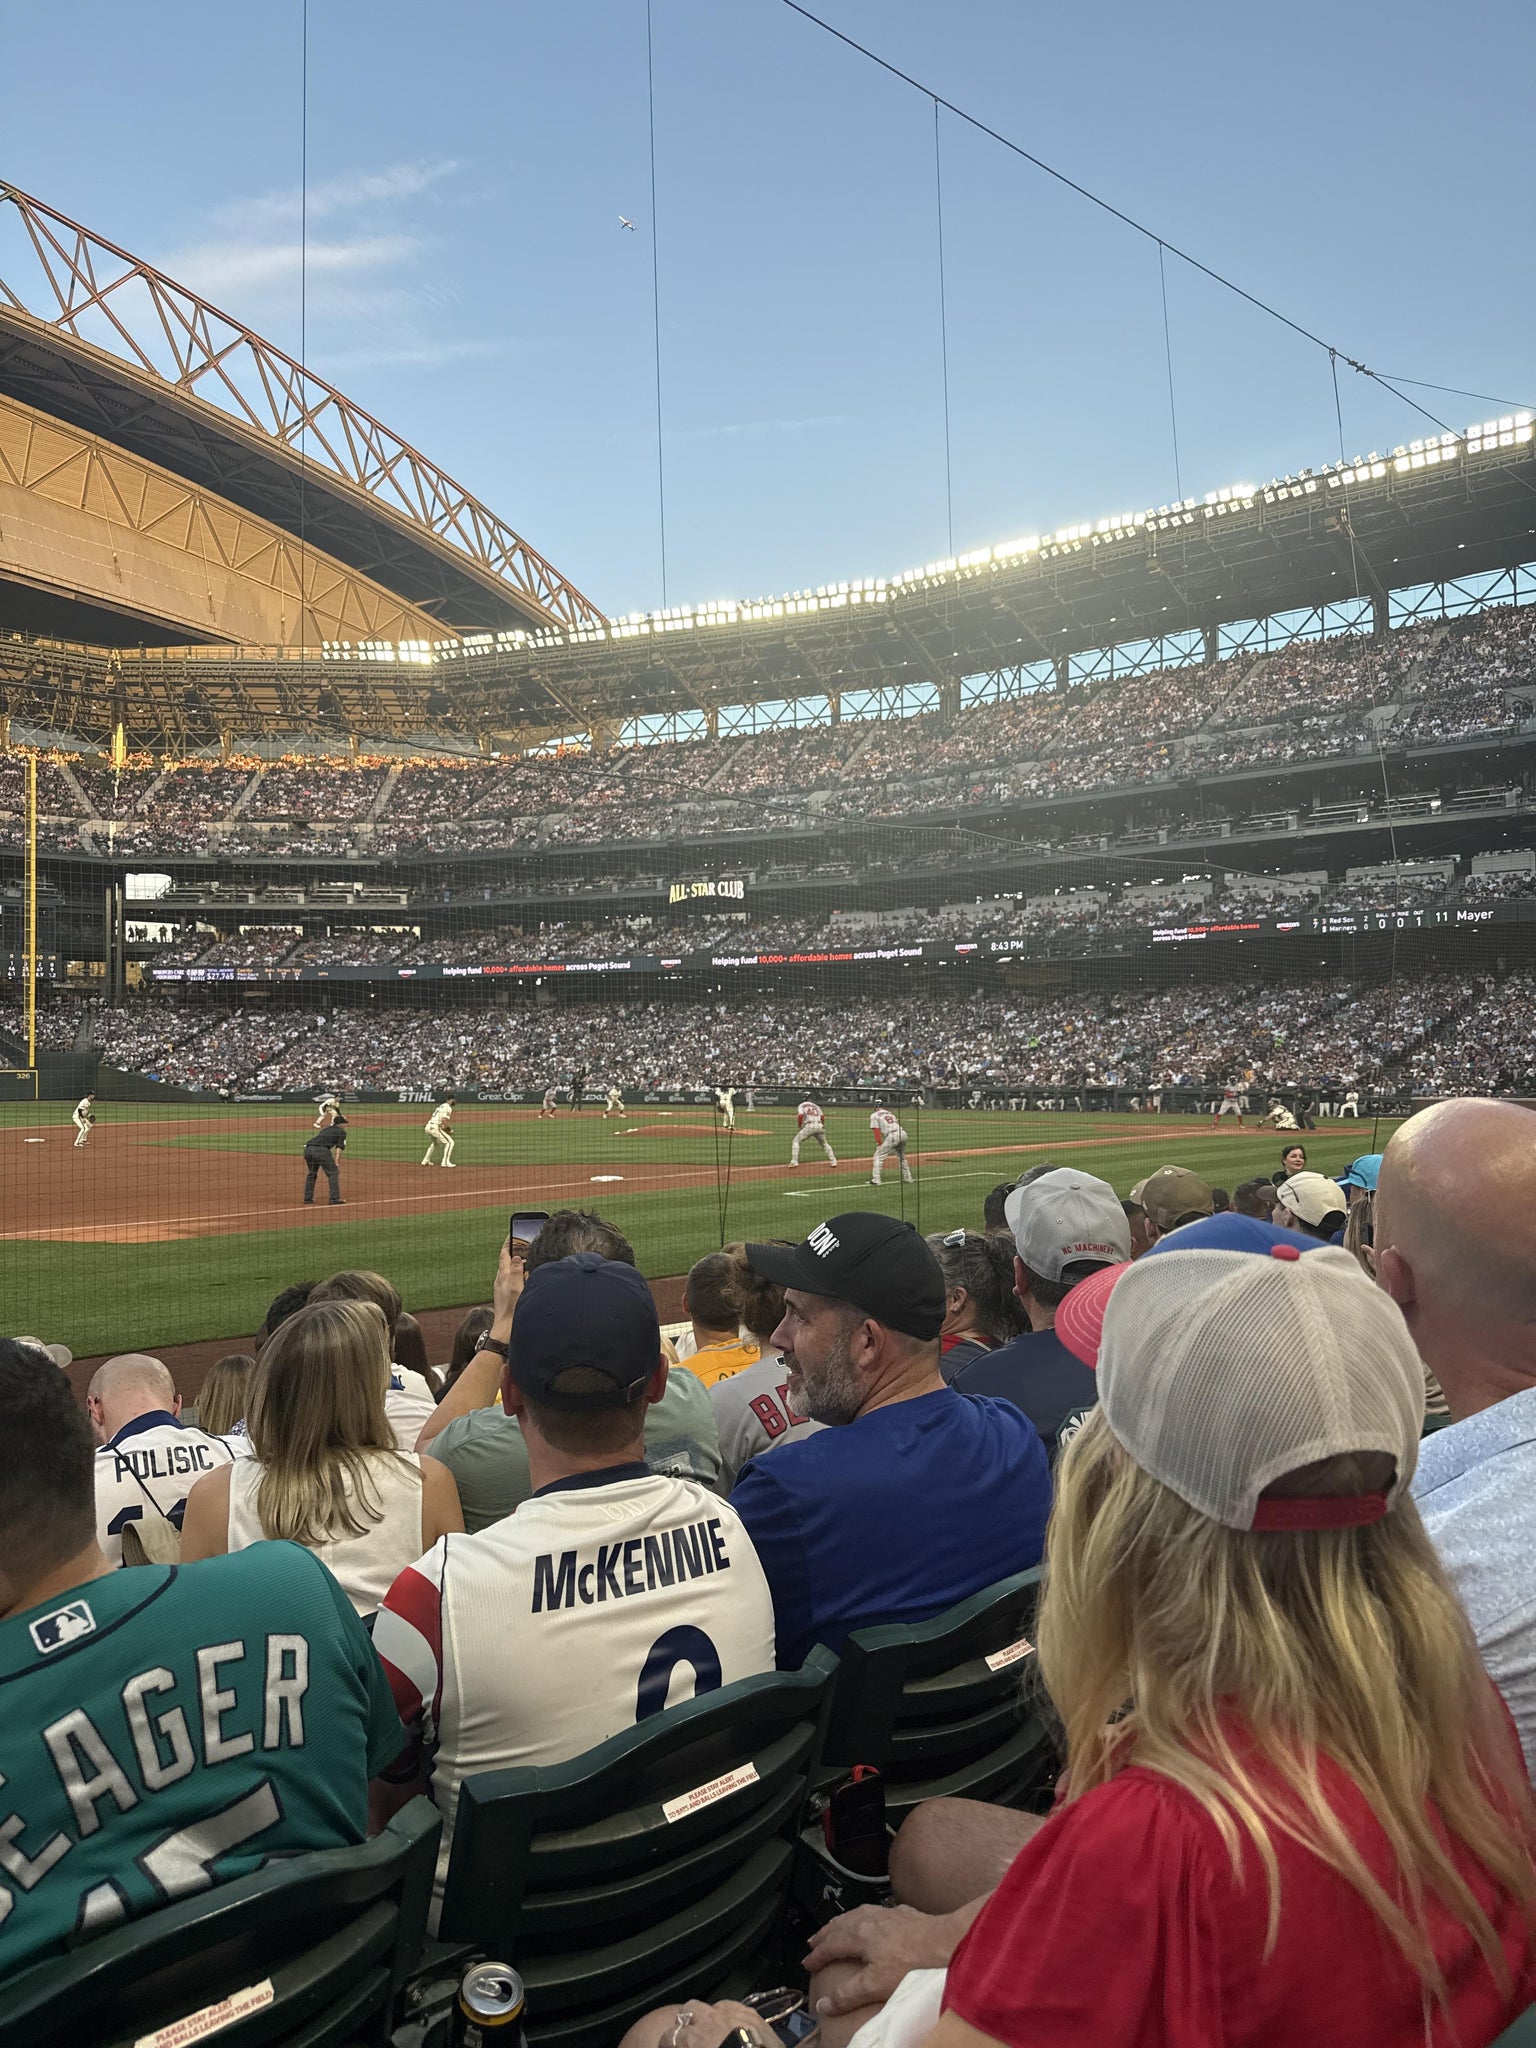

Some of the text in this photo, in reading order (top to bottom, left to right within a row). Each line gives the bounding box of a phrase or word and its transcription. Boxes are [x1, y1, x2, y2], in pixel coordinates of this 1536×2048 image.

[718, 880, 745, 899] CLUB
[1378, 916, 1421, 929] 0 0 1
[1435, 910, 1494, 922] 11 Mayer
[1152, 928, 1174, 936] Helping
[1210, 924, 1239, 932] affordable
[1188, 932, 1206, 940] Sound
[954, 943, 978, 951] amazon
[990, 940, 1024, 951] 8:43 PM
[712, 947, 922, 966] Helping fund 10,000+ affordable homes across Puget Sound
[443, 967, 466, 976] Helping
[468, 966, 482, 974] fund
[483, 966, 508, 974] 10,000+
[508, 964, 542, 973] affordable
[543, 964, 565, 972] homes
[589, 962, 608, 971] Puget
[609, 961, 630, 969] Sound
[398, 1092, 436, 1102] STIHL
[478, 1092, 524, 1102] Great Clips
[806, 1108, 819, 1116] 40
[1061, 1243, 1114, 1255] NC MACHINERY
[114, 1444, 214, 1483] PULISIC
[531, 1518, 731, 1614] McKENNIE
[0, 1633, 310, 1927] EAGER
[688, 1774, 734, 1801] PLEASE STAY ALERT
[676, 1805, 689, 1816] BATS
[690, 1799, 701, 1809] AND
[701, 1792, 716, 1804] BALLS
[716, 1782, 737, 1795] LEAVING
[737, 1777, 747, 1785] THE
[156, 2000, 233, 2042] PLEASE STAY ALERT
[174, 2027, 200, 2044] BALLS
[200, 2011, 235, 2032] LEAVING
[236, 2002, 251, 2015] THE
[251, 1990, 273, 2009] FIELD
